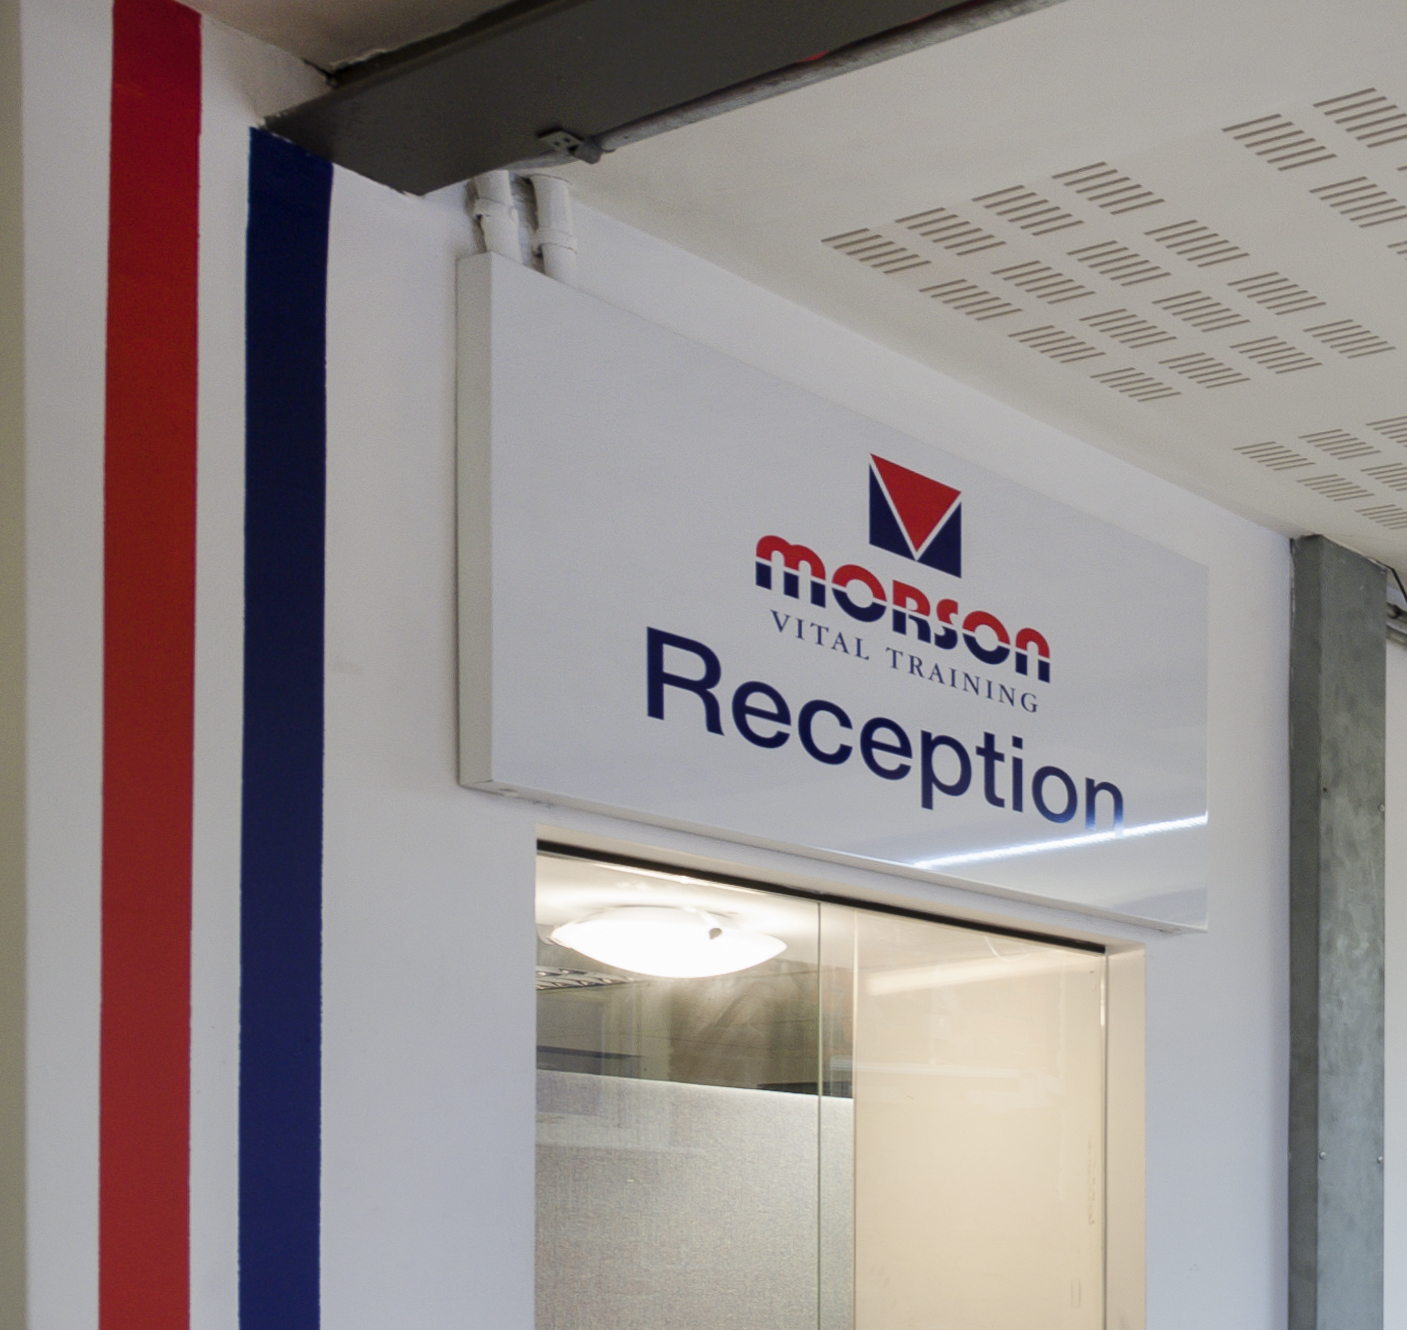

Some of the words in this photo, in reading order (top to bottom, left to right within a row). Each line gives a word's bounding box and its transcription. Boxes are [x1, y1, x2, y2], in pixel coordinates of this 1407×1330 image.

[645, 625, 1125, 838] Reception
[770, 609, 869, 662] VITAL
[886, 646, 1039, 714] TRAINING
